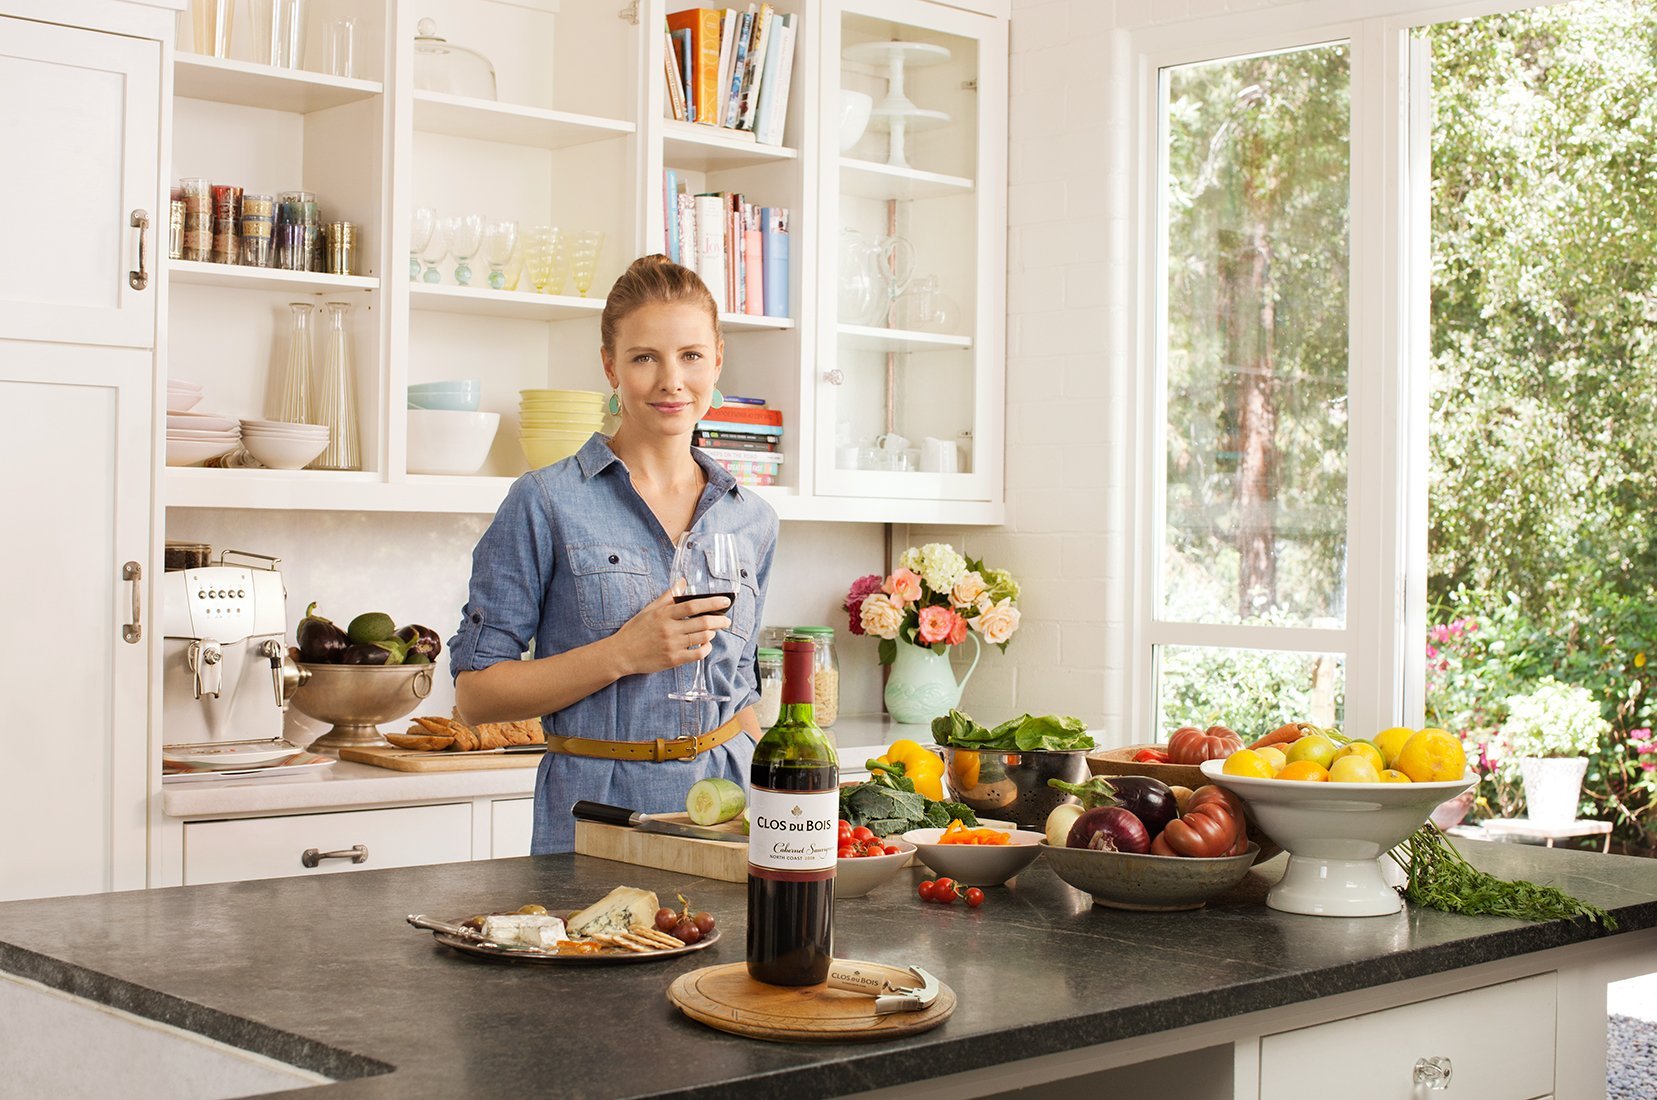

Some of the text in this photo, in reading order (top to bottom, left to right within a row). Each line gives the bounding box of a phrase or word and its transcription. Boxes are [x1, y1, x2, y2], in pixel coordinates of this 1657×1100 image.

[757, 816, 787, 831] CLOS
[806, 819, 831, 832] BOIS
[773, 841, 804, 854] Cabernet
[831, 972, 850, 984] CLOS
[860, 977, 879, 987] BOIS
